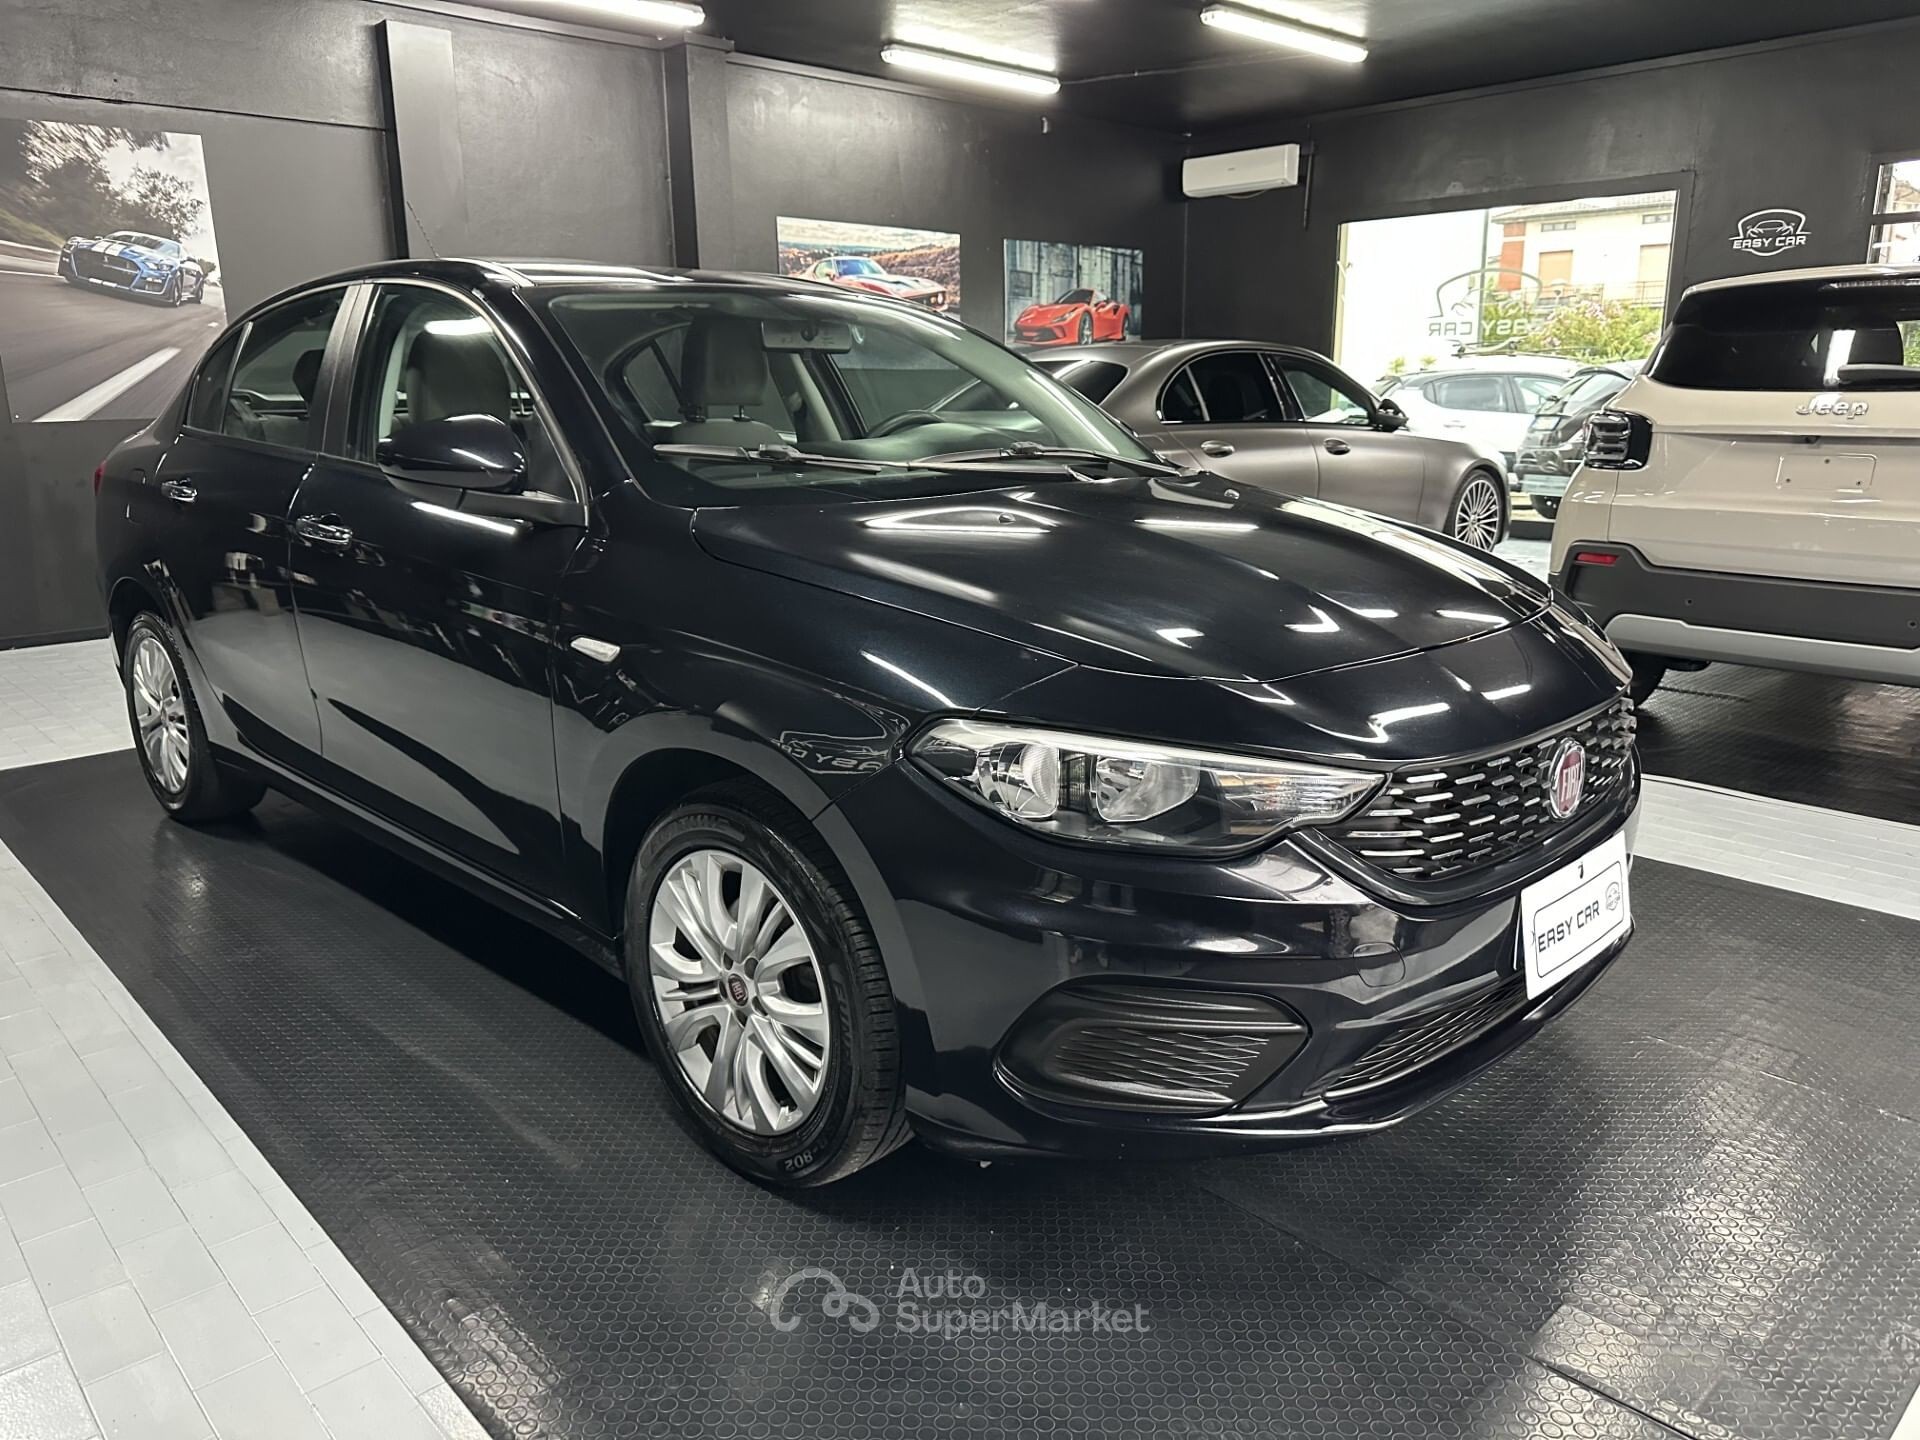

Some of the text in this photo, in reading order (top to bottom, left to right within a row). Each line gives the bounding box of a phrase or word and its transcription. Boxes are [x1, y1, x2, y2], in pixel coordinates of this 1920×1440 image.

[1733, 236, 1806, 249] EASY CAR
[1796, 395, 1868, 418] Jeep
[1560, 762, 1581, 803] FIAT
[1538, 916, 1573, 952] EASY
[1577, 900, 1600, 929] CAR
